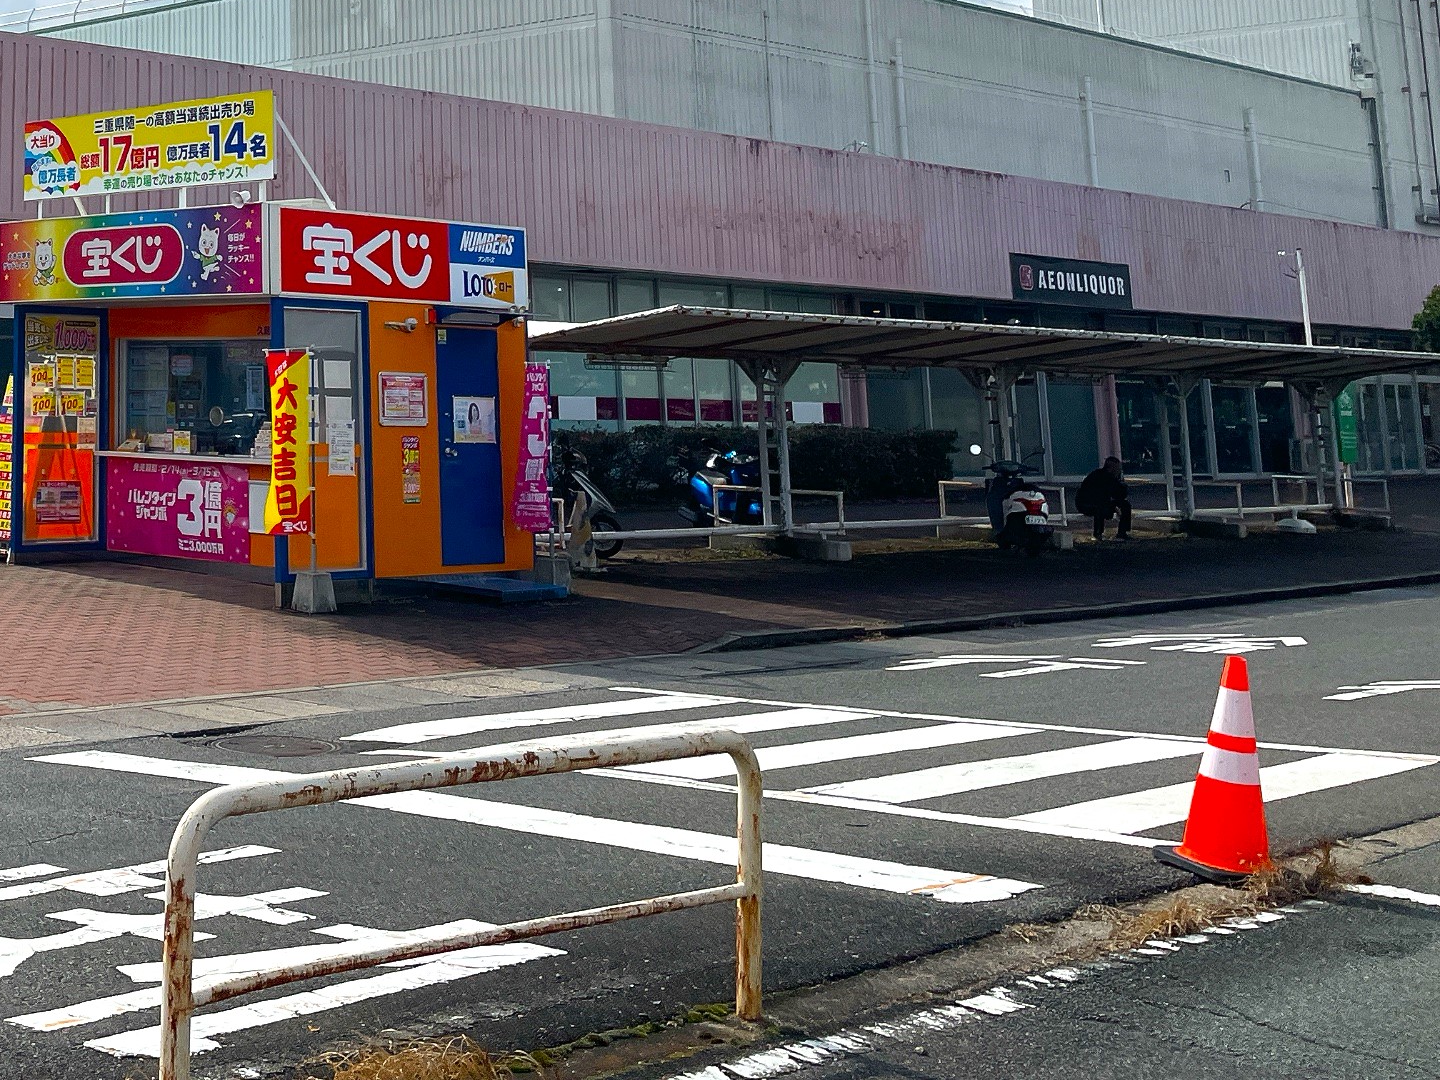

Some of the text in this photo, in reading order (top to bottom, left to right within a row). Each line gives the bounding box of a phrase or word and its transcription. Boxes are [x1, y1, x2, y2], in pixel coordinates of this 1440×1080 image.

[30, 134, 55, 149] 大当り
[80, 121, 266, 173] 総額17億円 億万長者14名
[38, 166, 76, 185] 億万長者
[227, 244, 250, 253] ラッキー
[459, 230, 515, 256] NUMBERS
[81, 236, 163, 278] 宝くじ
[303, 222, 433, 289] 宝くじ
[462, 270, 494, 298] LOTO
[498, 281, 513, 293] ロト
[273, 377, 299, 517] 大安吉日
[128, 488, 177, 507] バレンタイン
[135, 504, 168, 522] ジャンボ
[282, 520, 308, 533] 宝くじ
